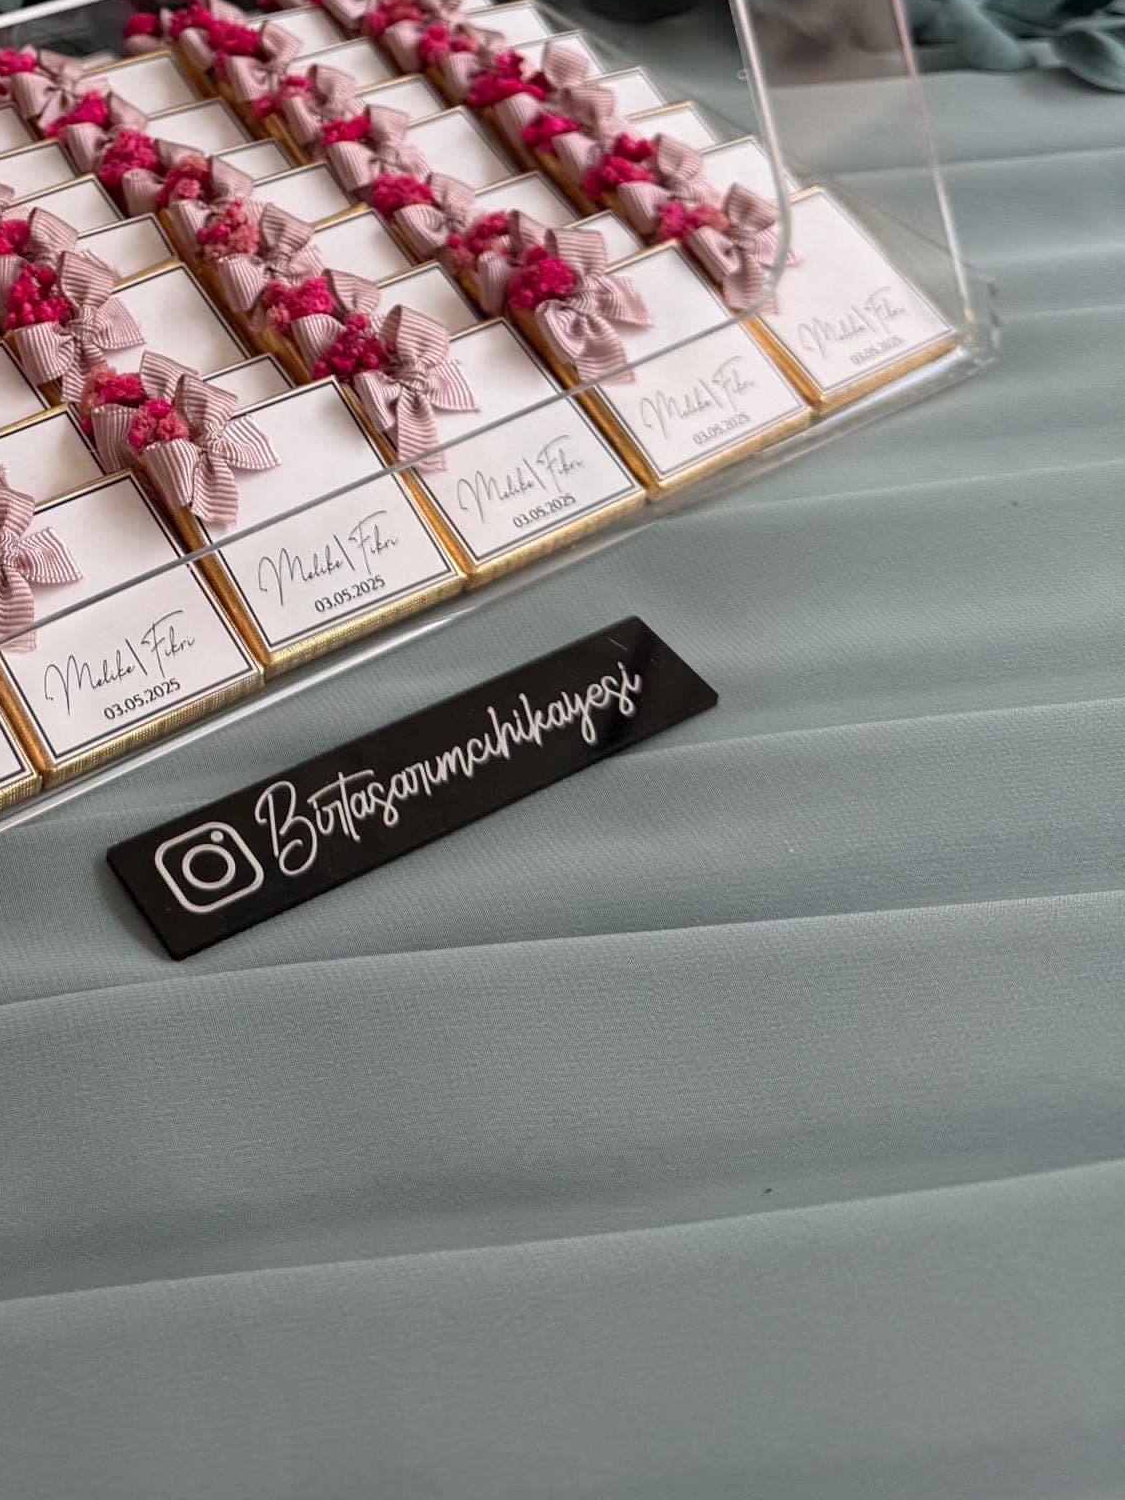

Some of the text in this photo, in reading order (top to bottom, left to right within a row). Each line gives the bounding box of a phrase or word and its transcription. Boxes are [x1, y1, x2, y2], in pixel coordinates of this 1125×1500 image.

[512, 492, 577, 528] 03.05.2025
[314, 574, 386, 613] 03.05.2025
[103, 677, 181, 720] 03.05.2025
